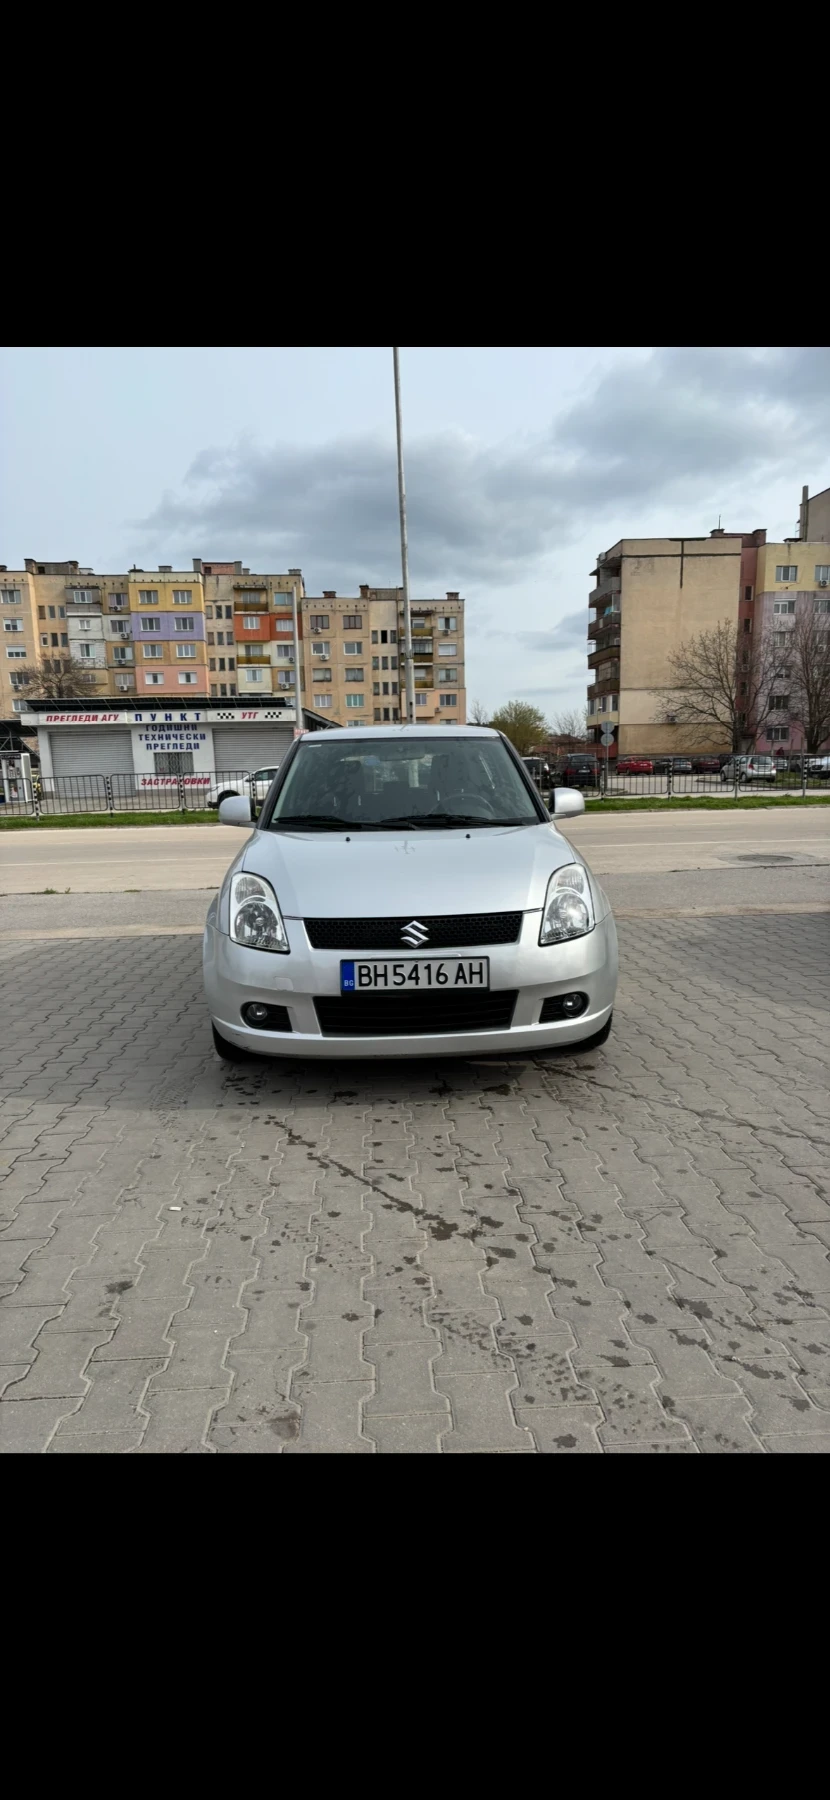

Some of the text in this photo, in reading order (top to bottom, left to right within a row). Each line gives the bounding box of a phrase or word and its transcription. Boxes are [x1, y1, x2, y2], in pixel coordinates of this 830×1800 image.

[46, 713, 120, 723] ПРЕГЛЕДИ АГУ
[134, 712, 202, 722] ПУНКТ
[241, 711, 259, 720] УТГ
[145, 723, 198, 732] ГОДИШНИ
[138, 733, 206, 741] ТЕХНИЧЕСКИ
[146, 742, 200, 751] ПРЕГЛЕДИ
[141, 777, 211, 786] ЗАСТРАОВКИ
[343, 979, 354, 987] BG
